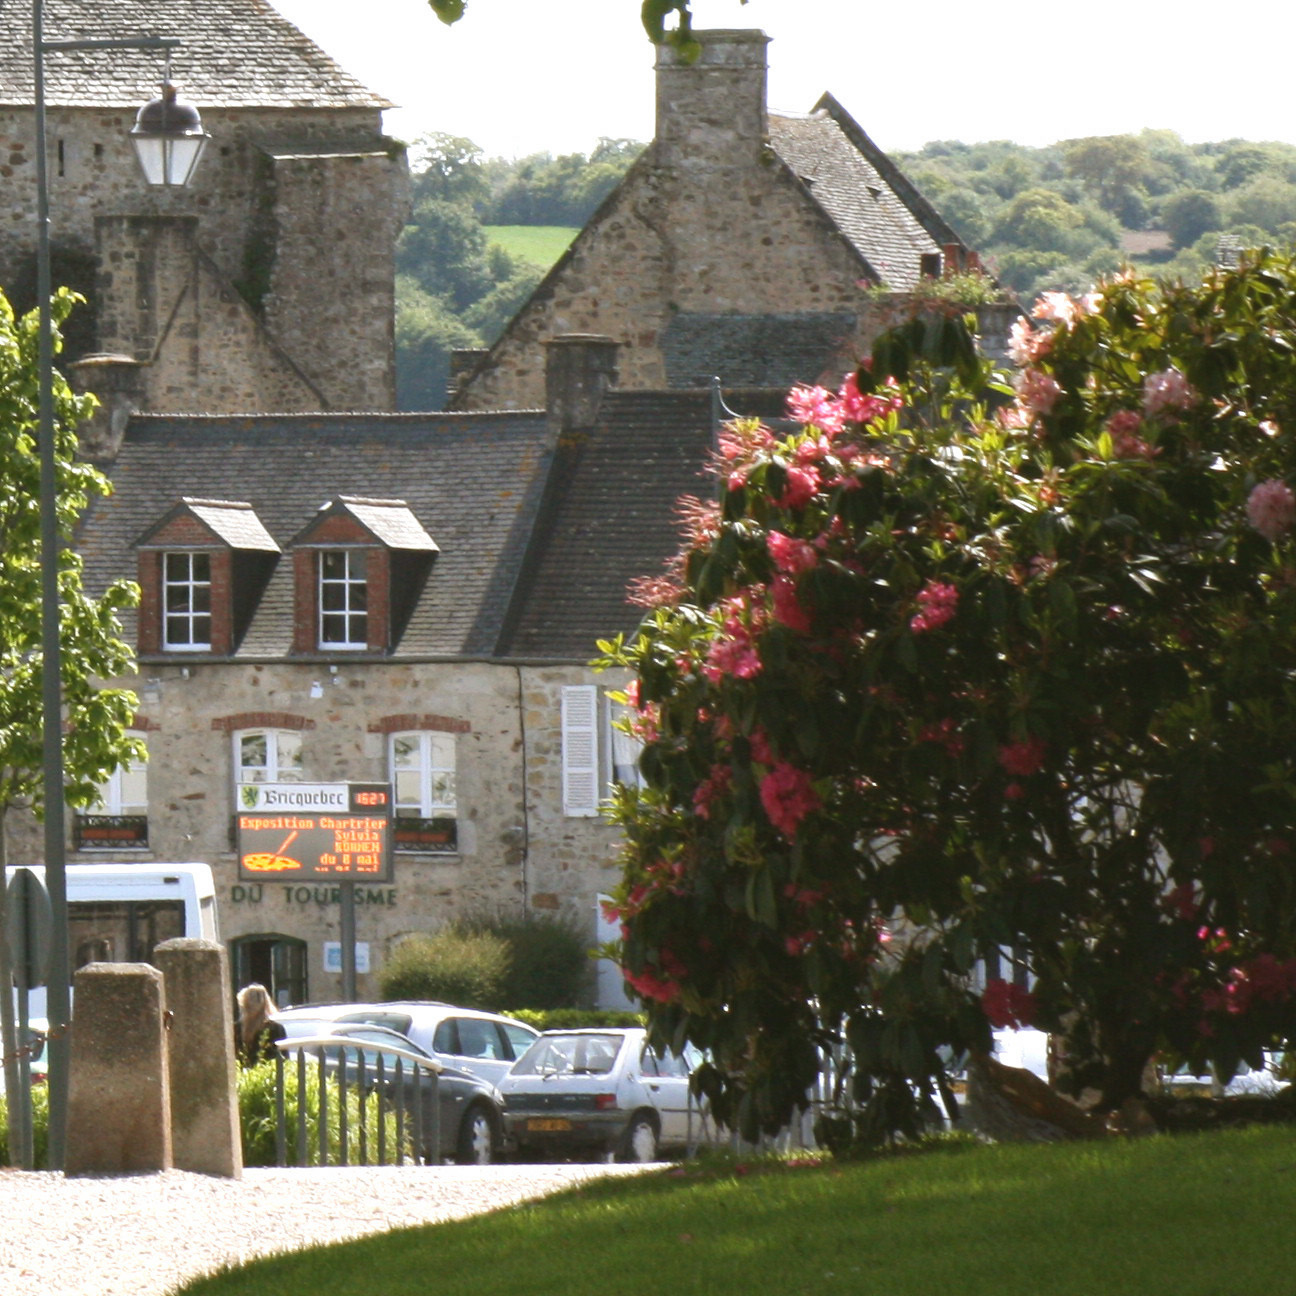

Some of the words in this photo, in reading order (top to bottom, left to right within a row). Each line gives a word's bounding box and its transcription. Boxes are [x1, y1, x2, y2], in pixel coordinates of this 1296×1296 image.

[264, 790, 344, 807] Bricquebec
[240, 817, 314, 830] Exposition
[319, 817, 387, 829] Chartrier
[335, 830, 380, 842] Sylvia
[320, 853, 337, 865] du
[356, 853, 379, 865] mai
[231, 884, 263, 904] DU
[282, 886, 398, 905] TOURSME
